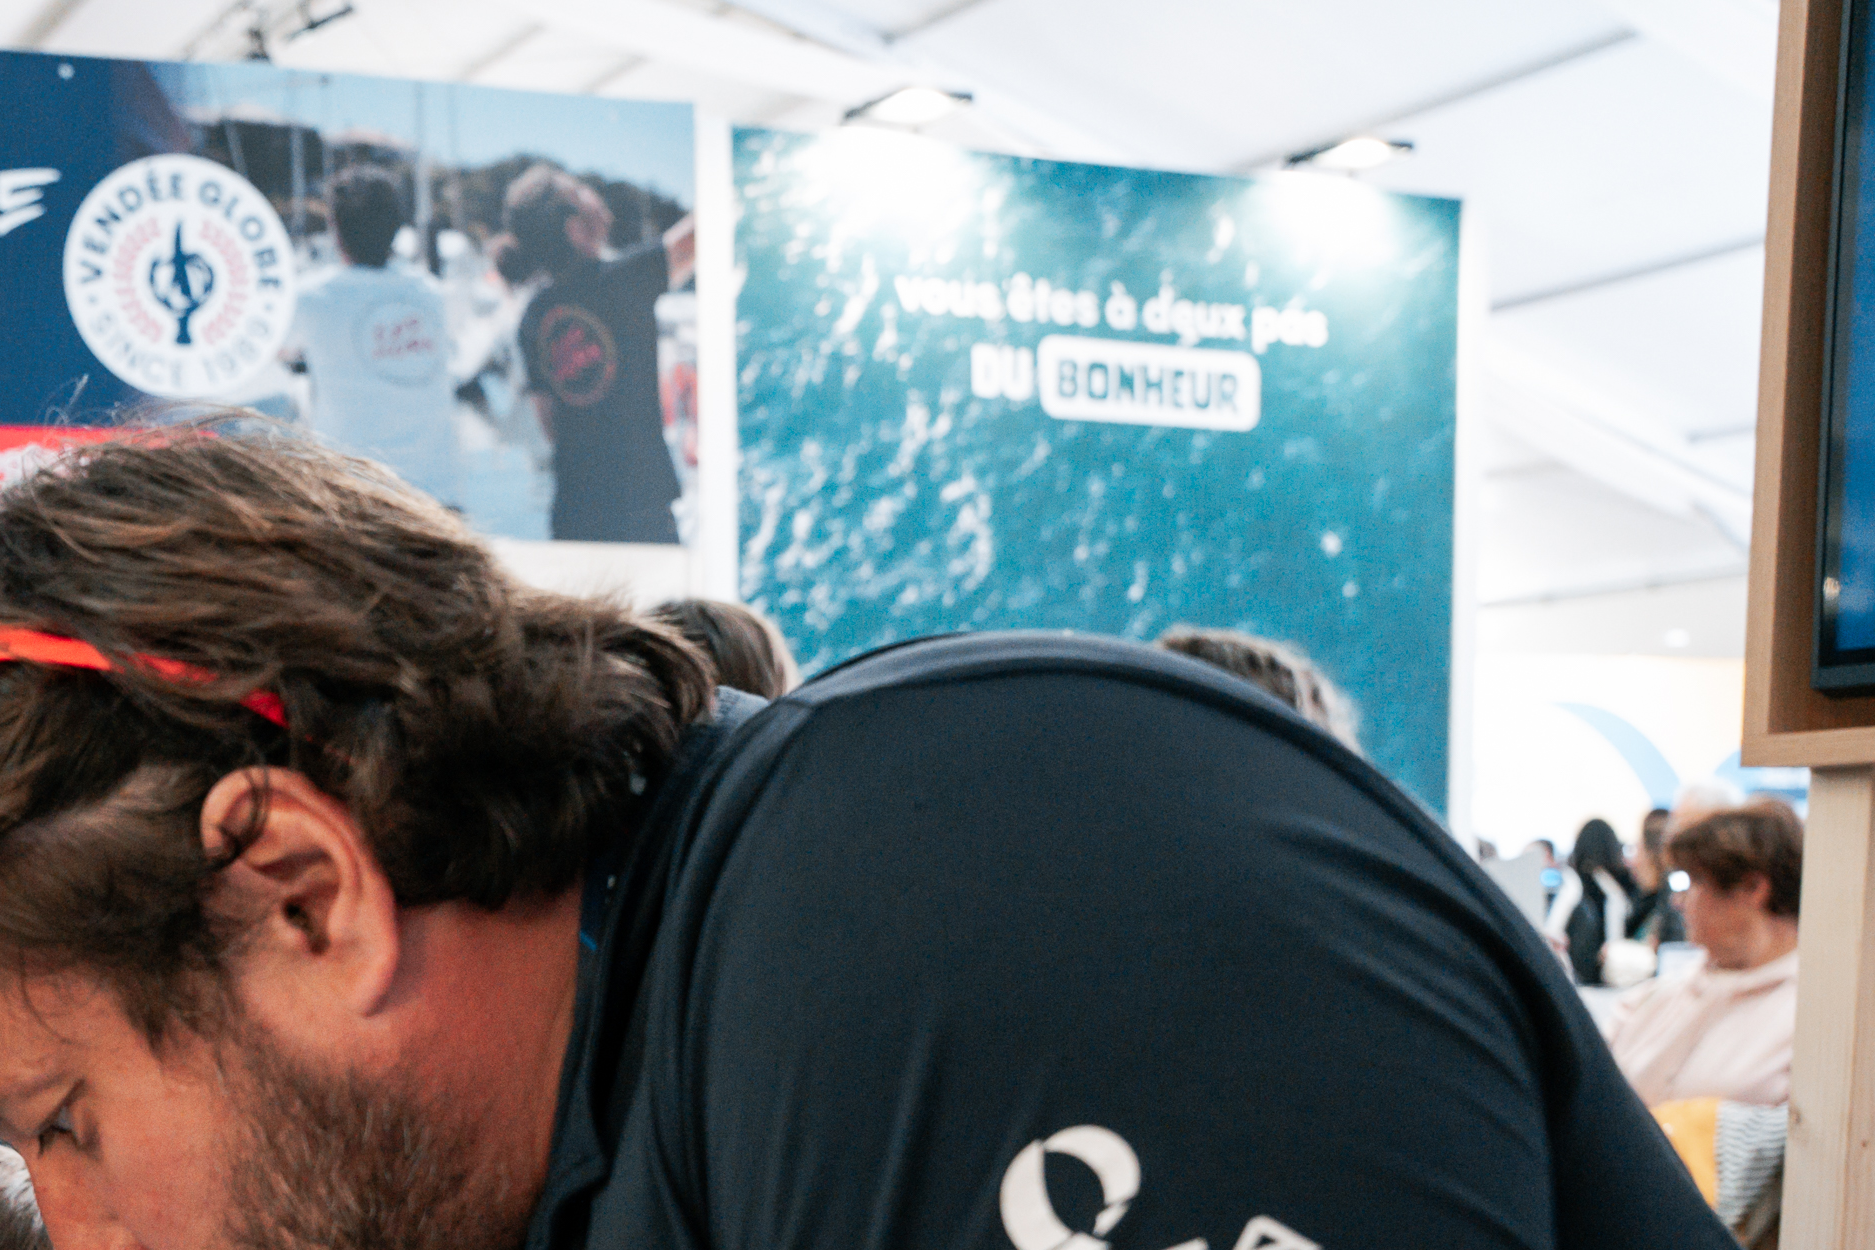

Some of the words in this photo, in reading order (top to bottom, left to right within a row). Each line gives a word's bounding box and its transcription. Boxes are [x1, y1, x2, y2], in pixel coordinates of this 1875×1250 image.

[79, 164, 185, 285] VENDÉE
[199, 180, 281, 288] GLOBE
[894, 274, 1003, 321] vous
[1005, 272, 1100, 328] êtes
[1104, 280, 1137, 331] à
[1251, 306, 1330, 354] pas
[970, 343, 1034, 400] DU
[1056, 359, 1239, 413] BONHEUR
